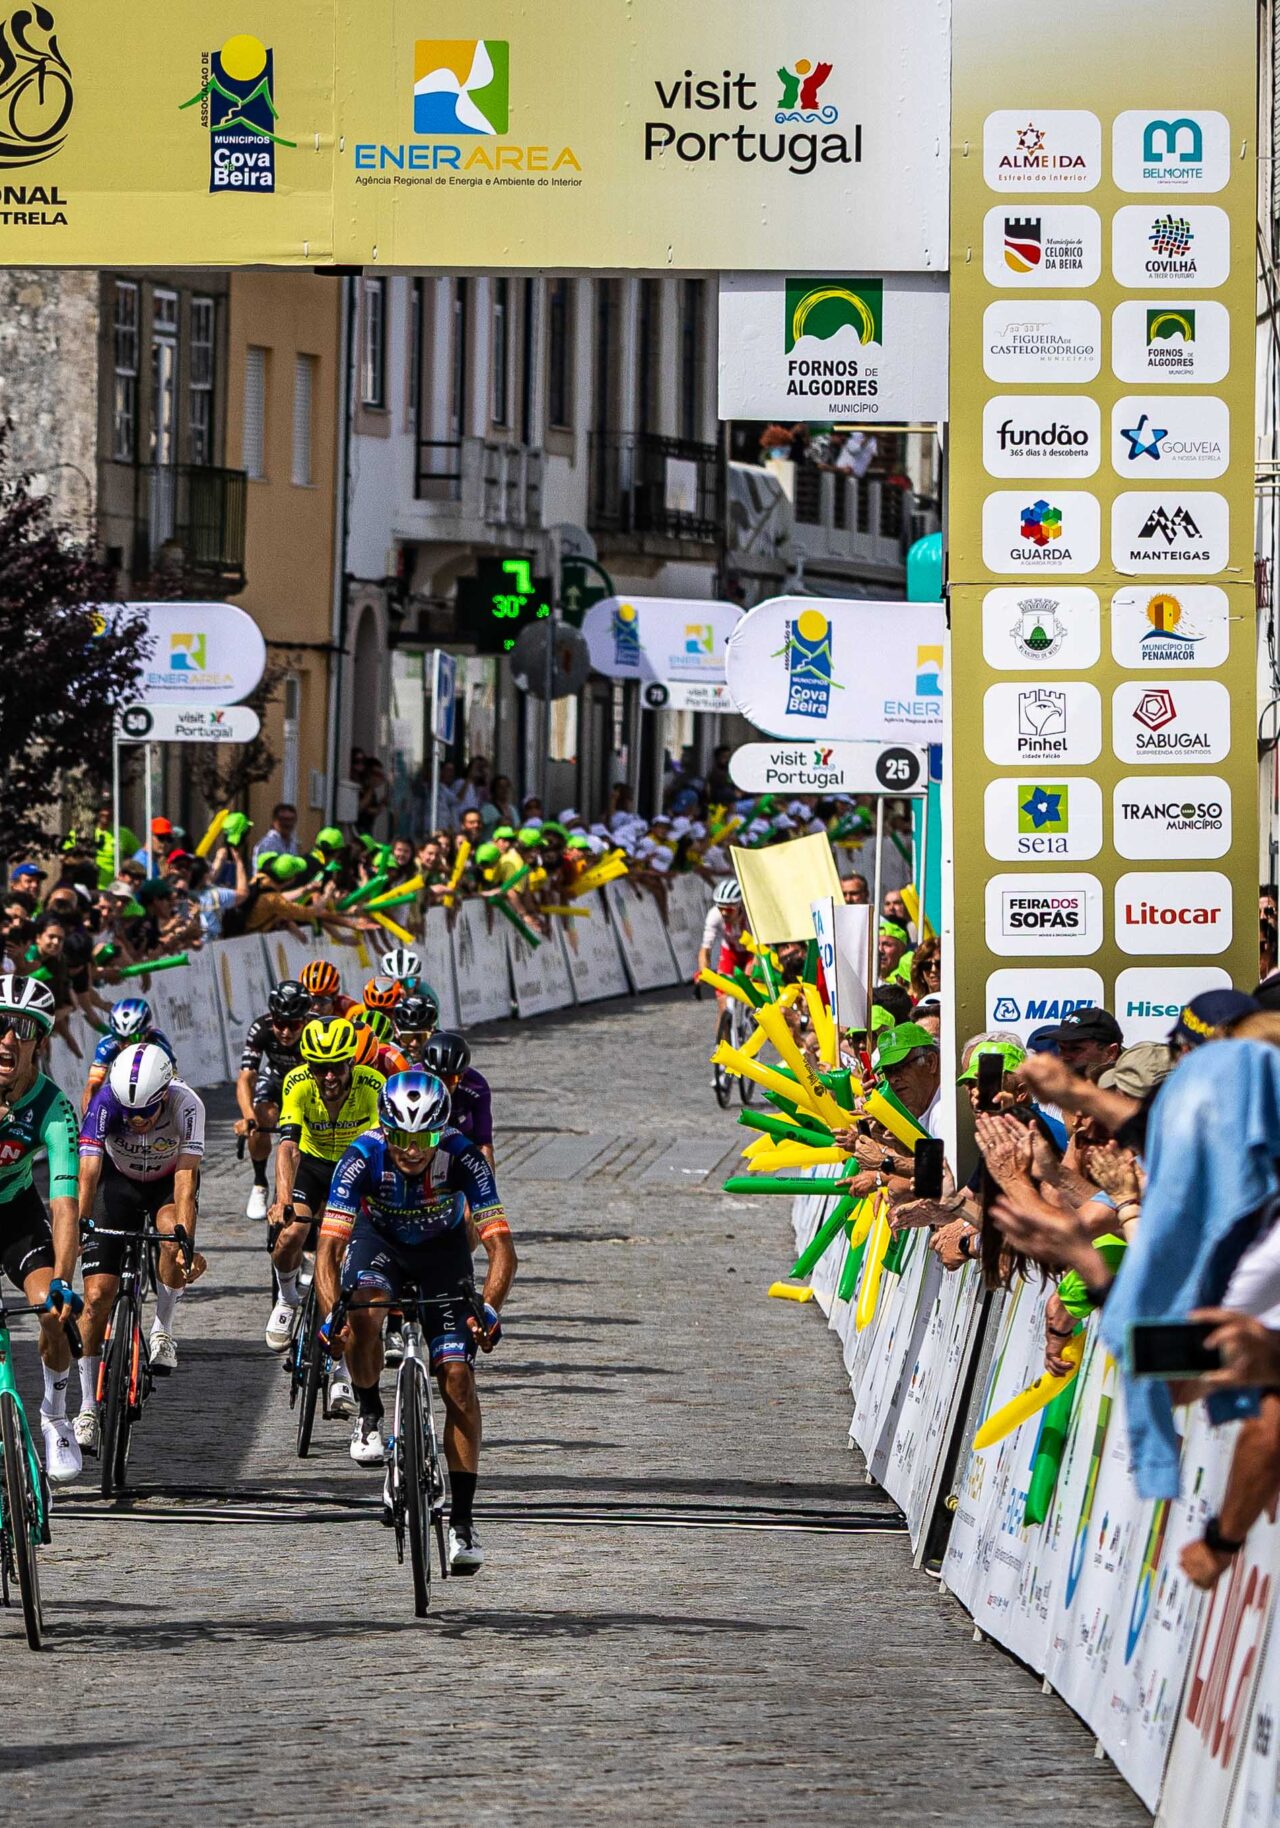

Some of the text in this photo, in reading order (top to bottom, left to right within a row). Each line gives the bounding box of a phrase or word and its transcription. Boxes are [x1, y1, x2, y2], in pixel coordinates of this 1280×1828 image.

[654, 69, 758, 110] visit
[215, 136, 270, 145] MUNICIPIOS
[645, 122, 862, 175] Portugal
[214, 148, 270, 167] Cova
[356, 145, 582, 171] ENERAREA
[999, 156, 1086, 167] ALMEIDA
[214, 168, 273, 186] Beira
[1143, 168, 1202, 178] BELMONTE
[356, 176, 391, 185] Agência
[394, 176, 433, 187] Regional
[435, 177, 446, 185] de
[450, 177, 483, 187] Energia
[493, 177, 535, 186] Ambiente
[537, 177, 549, 186] do
[552, 178, 582, 186] Interior
[1045, 247, 1082, 258] CELORICO
[1045, 259, 1082, 269] DA BEIRA
[1146, 259, 1197, 272] COVILHÃ
[1148, 349, 1183, 357] FORNOS
[788, 360, 878, 378] FORNOS DE
[1148, 358, 1194, 367] ALGODRES
[786, 378, 878, 398] ALGODRES
[828, 402, 879, 414] MUNICÍPIO
[997, 420, 1088, 450] fundão
[1162, 442, 1220, 453] GOUVEIA
[1010, 549, 1072, 560] GUARDA
[1130, 552, 1210, 561] MANTEIGAS
[1142, 651, 1194, 660] PENAMACOR
[791, 686, 827, 700] Cova
[789, 698, 827, 714] Beira
[884, 701, 940, 715] ENER
[1018, 738, 1067, 751] Pinhel
[1136, 733, 1211, 748] SABUGAL
[771, 750, 910, 780] visit 25
[766, 770, 844, 788] Portugal
[1122, 803, 1222, 820] TRANCOSO
[1018, 837, 1069, 853] seia
[1010, 909, 1079, 928] SOFÁS
[1125, 902, 1221, 924] Litocar
[346, 1157, 367, 1189] NIPPO
[461, 1153, 491, 1197] FANTINI
